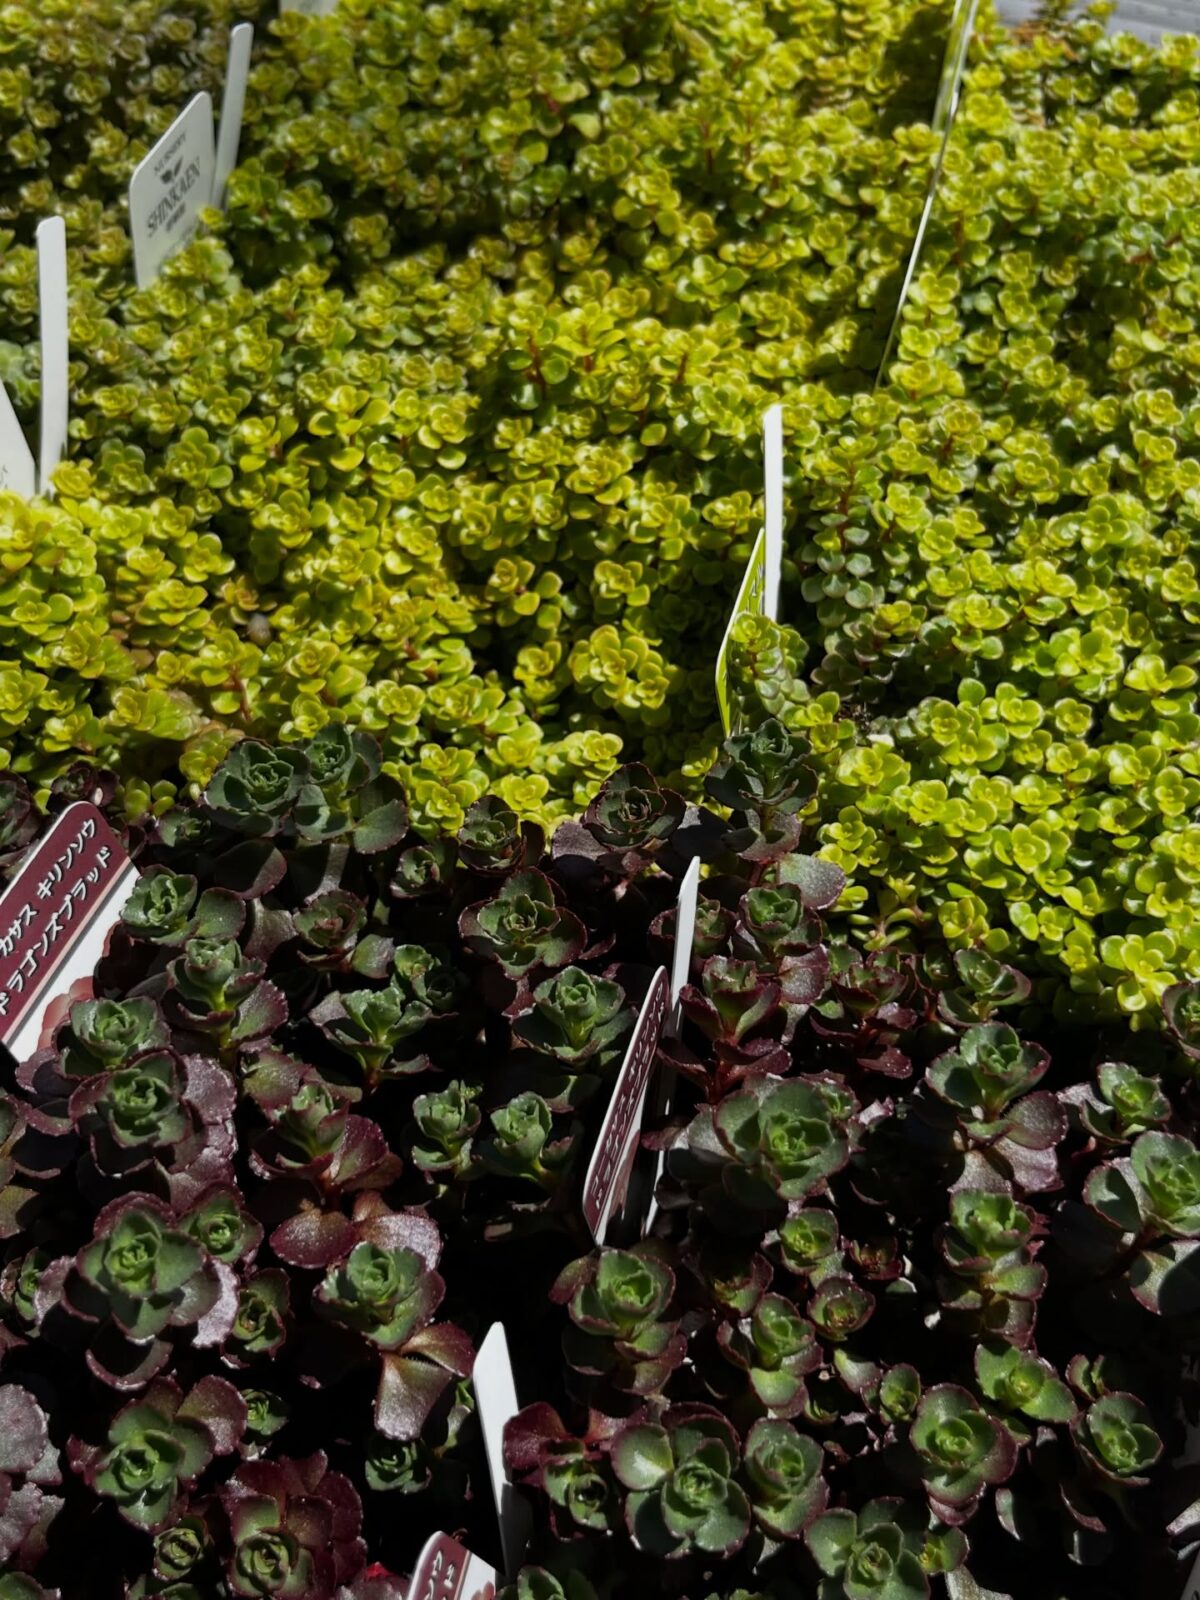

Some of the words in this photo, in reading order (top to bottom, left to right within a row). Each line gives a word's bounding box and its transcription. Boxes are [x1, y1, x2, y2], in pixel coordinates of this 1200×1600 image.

[37, 819, 95, 899] キリンソウ
